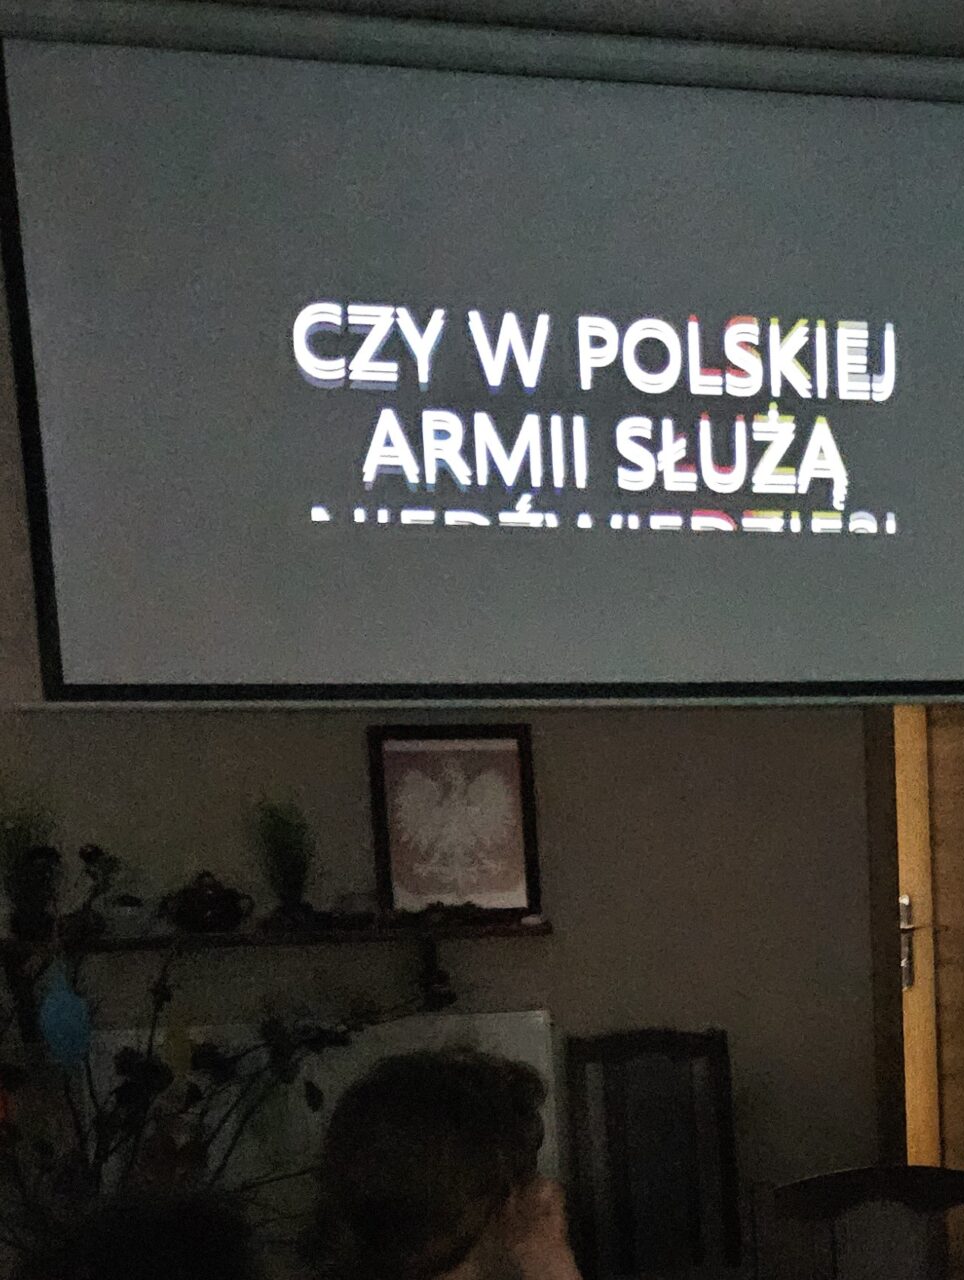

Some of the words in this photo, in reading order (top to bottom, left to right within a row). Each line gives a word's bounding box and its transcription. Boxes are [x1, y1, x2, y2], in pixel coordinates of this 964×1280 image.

[292, 302, 445, 387] CZY
[468, 310, 550, 391] W
[577, 314, 897, 402] POLSKIEJ
[361, 408, 589, 490] ARMII
[616, 402, 849, 511] SŁUŻĄ
